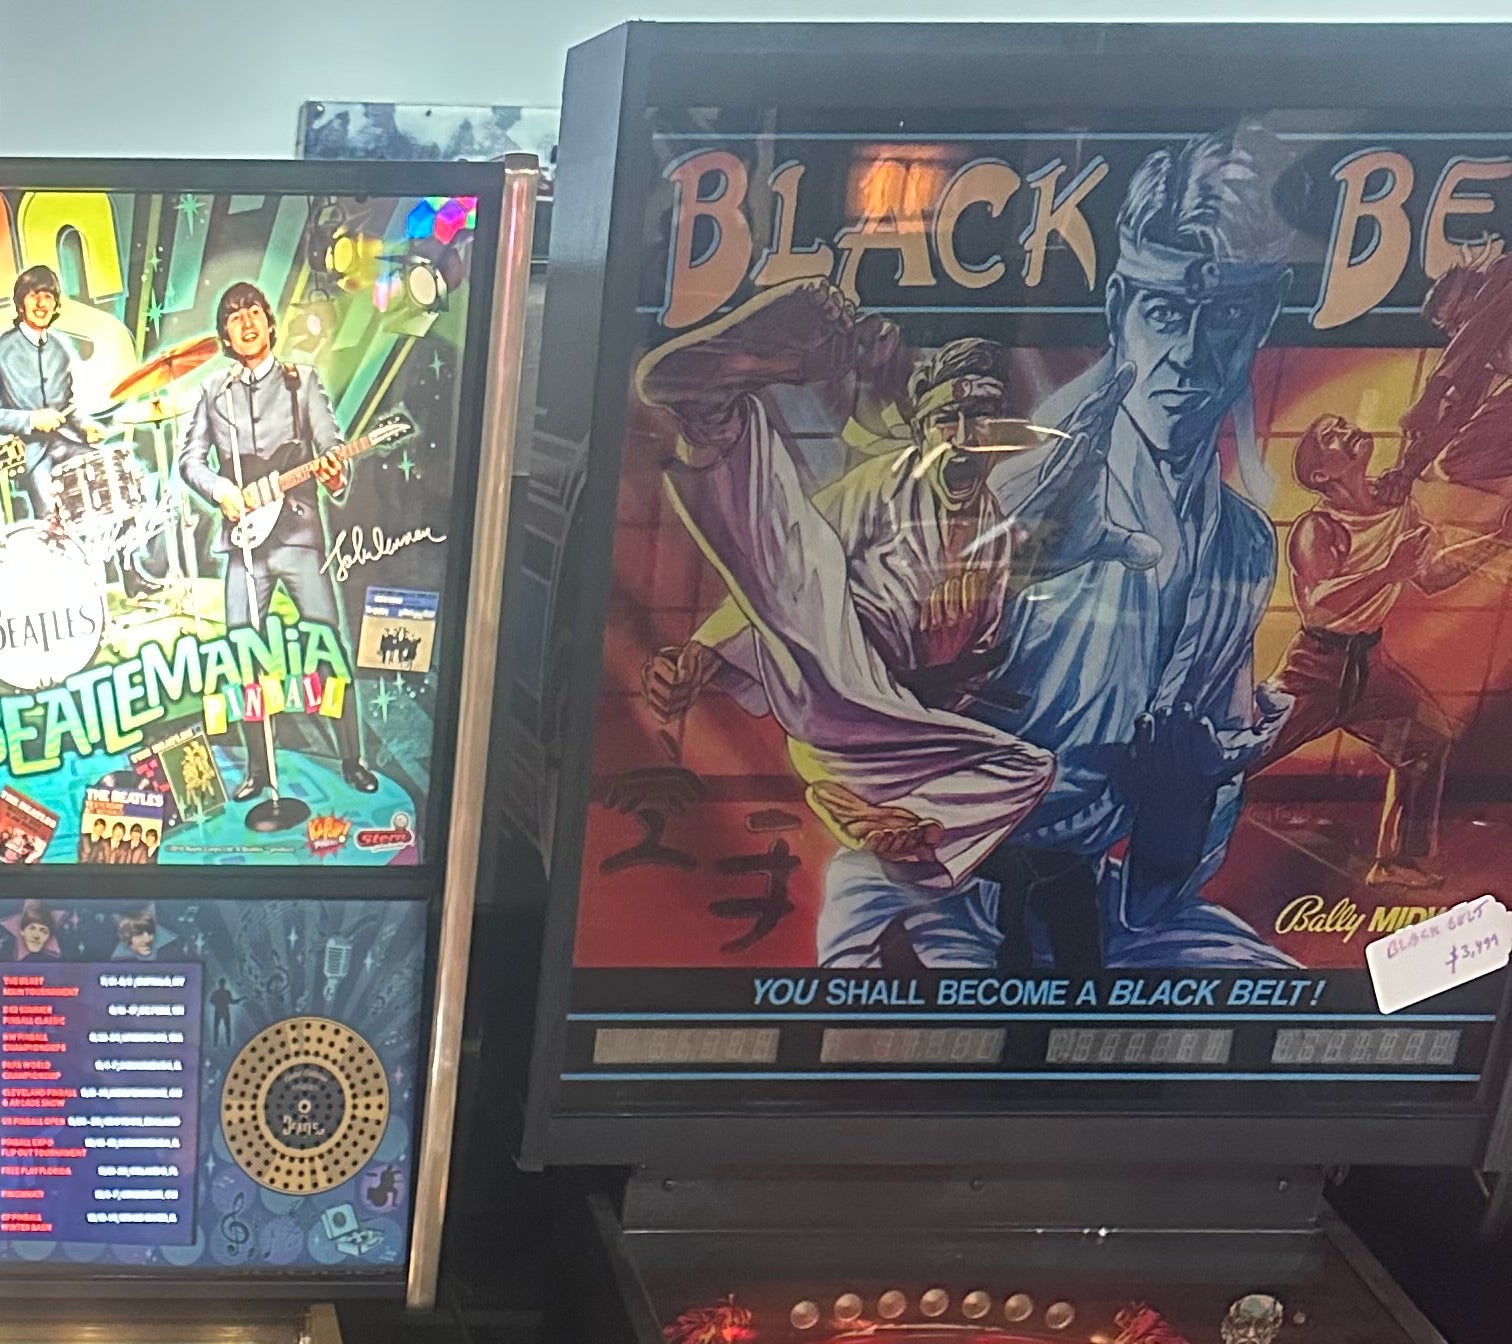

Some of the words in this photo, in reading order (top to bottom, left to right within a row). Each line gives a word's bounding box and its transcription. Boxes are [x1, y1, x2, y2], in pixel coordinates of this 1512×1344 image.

[661, 145, 1108, 329] BLACK
[202, 670, 347, 735] PINBALL
[1275, 894, 1367, 944] Bally
[752, 979, 820, 1006] YOU
[826, 979, 925, 1006] SHALL
[936, 979, 1069, 1006] BECOME
[1076, 979, 1097, 1006] A
[1109, 979, 1223, 1007] BLACK
[1227, 979, 1328, 1007] BELT!
